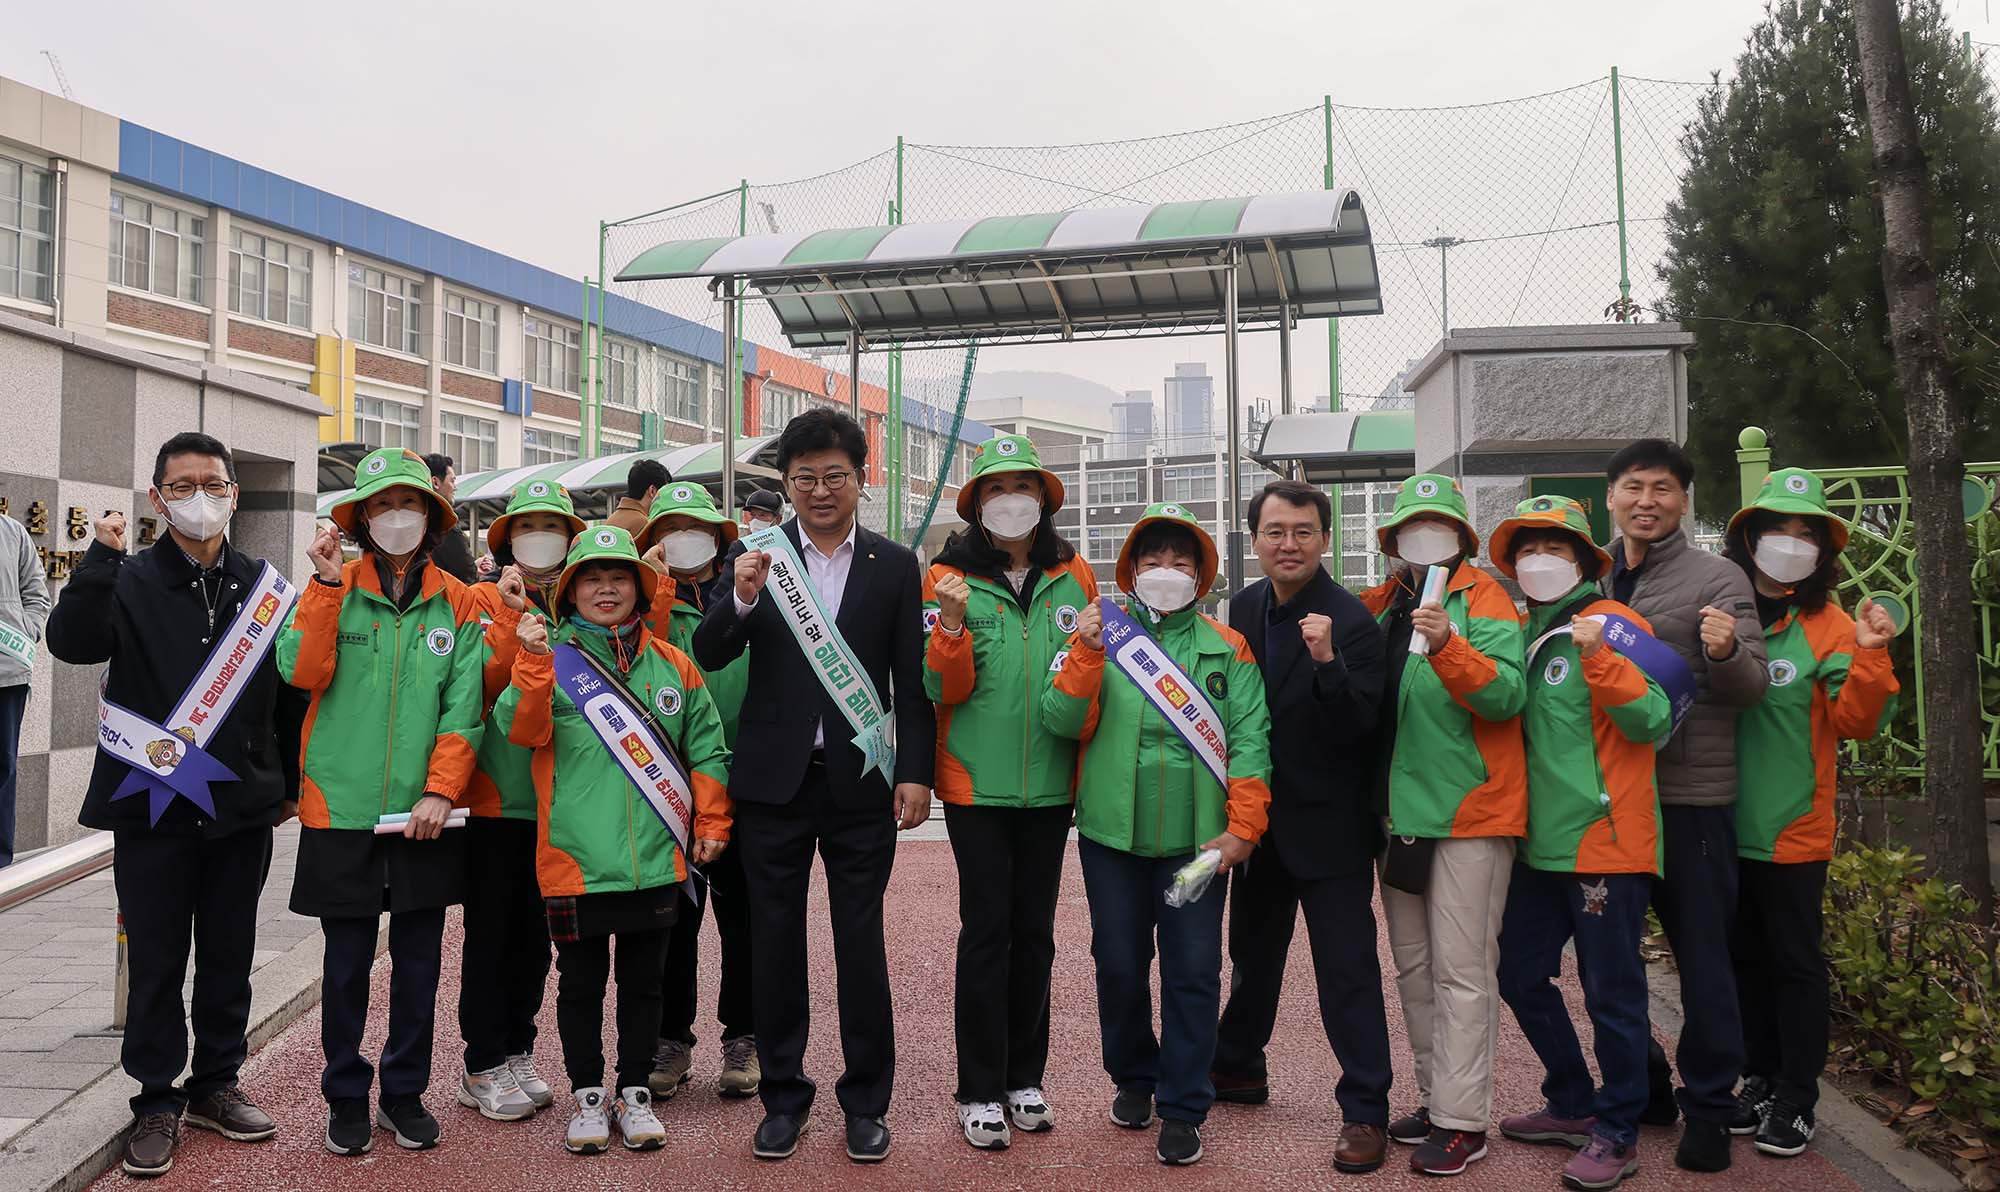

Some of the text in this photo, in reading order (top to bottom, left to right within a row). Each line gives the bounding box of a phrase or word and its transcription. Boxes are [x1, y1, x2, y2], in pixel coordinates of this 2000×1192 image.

[771, 561, 814, 624] 횡단보도
[804, 624, 824, 644] 앞
[813, 641, 855, 690] 일단
[1130, 648, 1161, 677] 매월
[188, 706, 210, 727] 날
[598, 703, 628, 734] 매월
